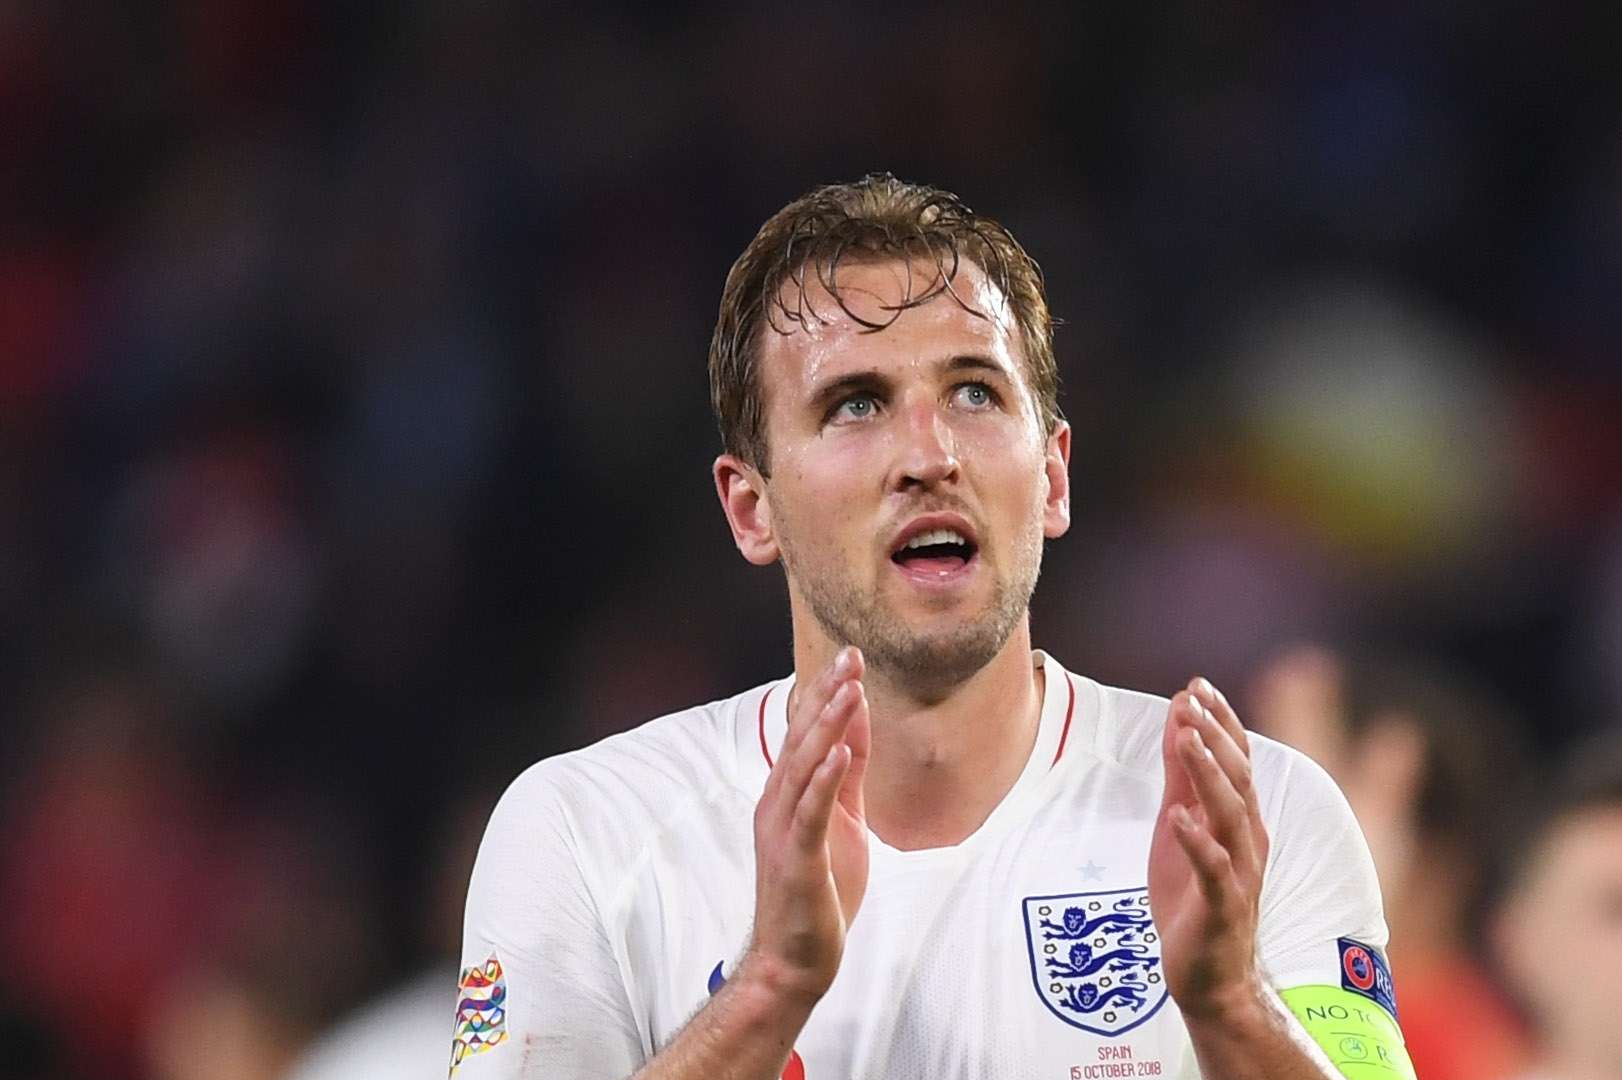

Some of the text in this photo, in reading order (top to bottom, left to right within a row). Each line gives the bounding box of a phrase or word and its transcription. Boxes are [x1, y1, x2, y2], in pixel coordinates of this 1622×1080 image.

[1305, 1004, 1349, 1021] NO
[1097, 1045, 1132, 1060] SPAIN
[1070, 1061, 1162, 1080] 15 OCTOBER 2018
